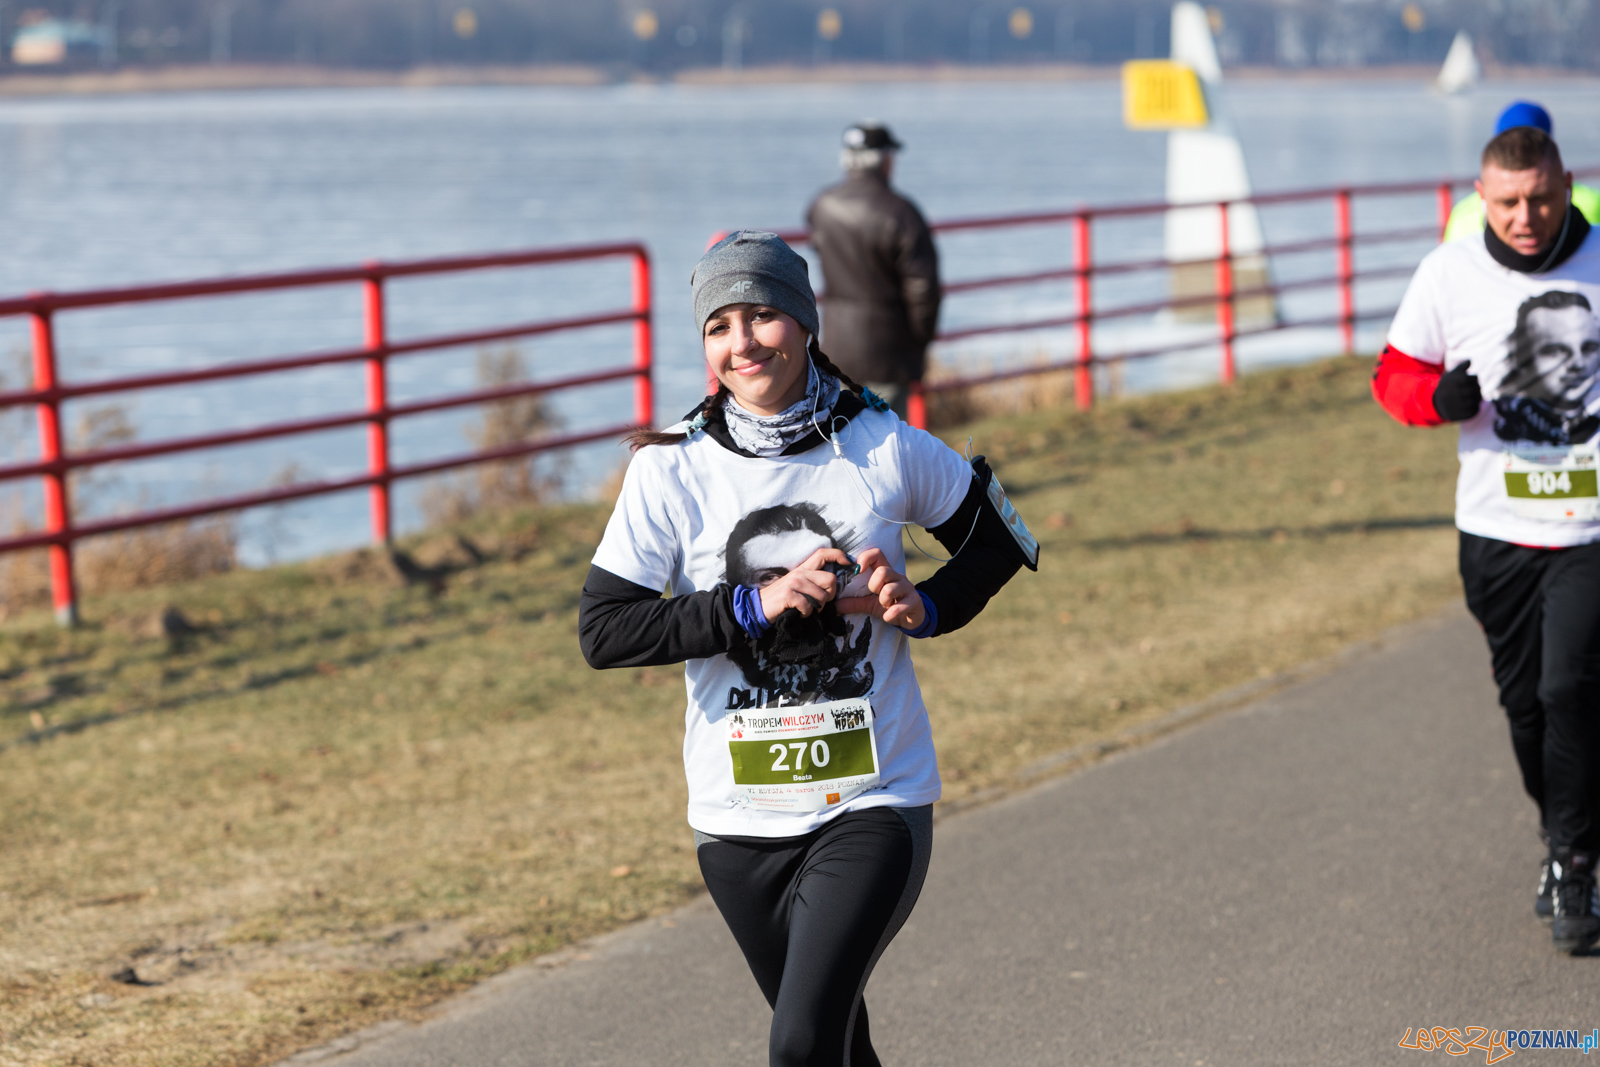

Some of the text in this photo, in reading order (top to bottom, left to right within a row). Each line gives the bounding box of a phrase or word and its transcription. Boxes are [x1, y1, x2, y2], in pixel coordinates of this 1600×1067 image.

[1526, 470, 1572, 495] 904
[747, 712, 825, 729] TROPEMWILCZYM
[768, 739, 830, 772] 270
[792, 774, 813, 782] Beata
